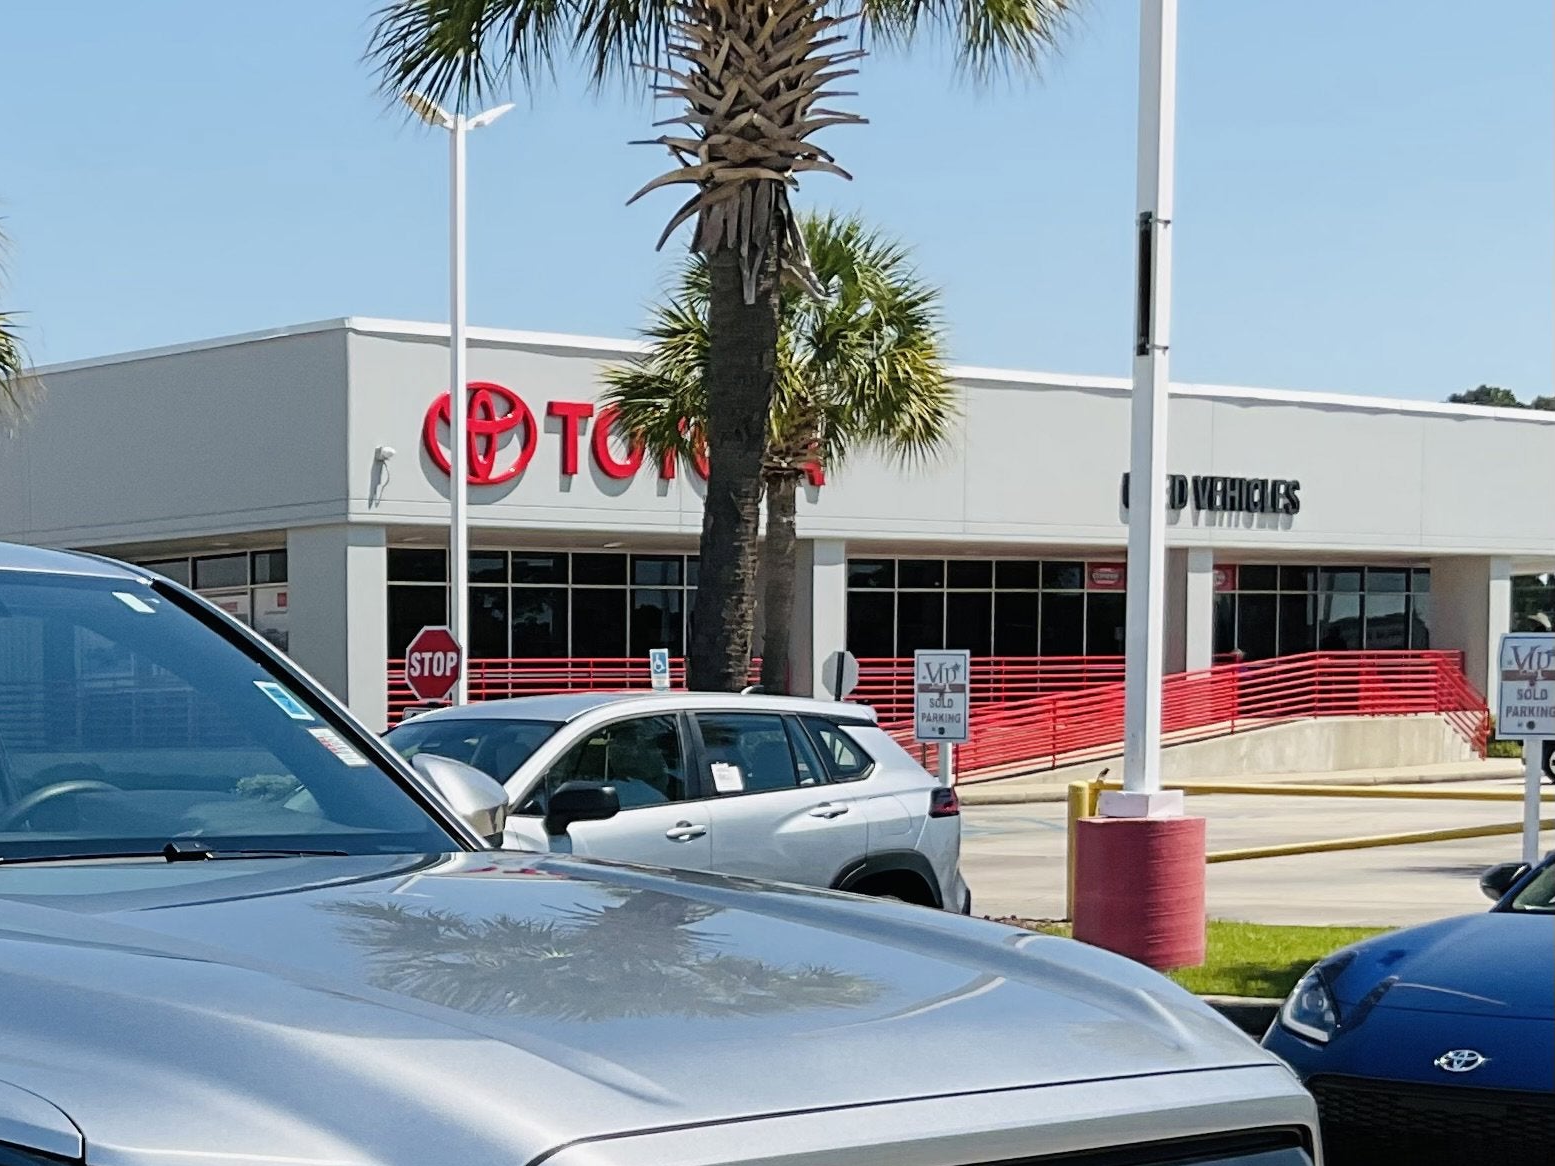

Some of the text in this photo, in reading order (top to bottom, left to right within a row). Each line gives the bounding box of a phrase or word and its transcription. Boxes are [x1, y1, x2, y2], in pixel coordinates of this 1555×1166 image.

[1192, 476, 1301, 515] VEHICLES
[409, 651, 458, 677] STOP
[1517, 689, 1548, 700] SOLD
[929, 697, 954, 709] SOLD
[921, 712, 961, 723] PARKING
[1506, 706, 1555, 718] PARKING
